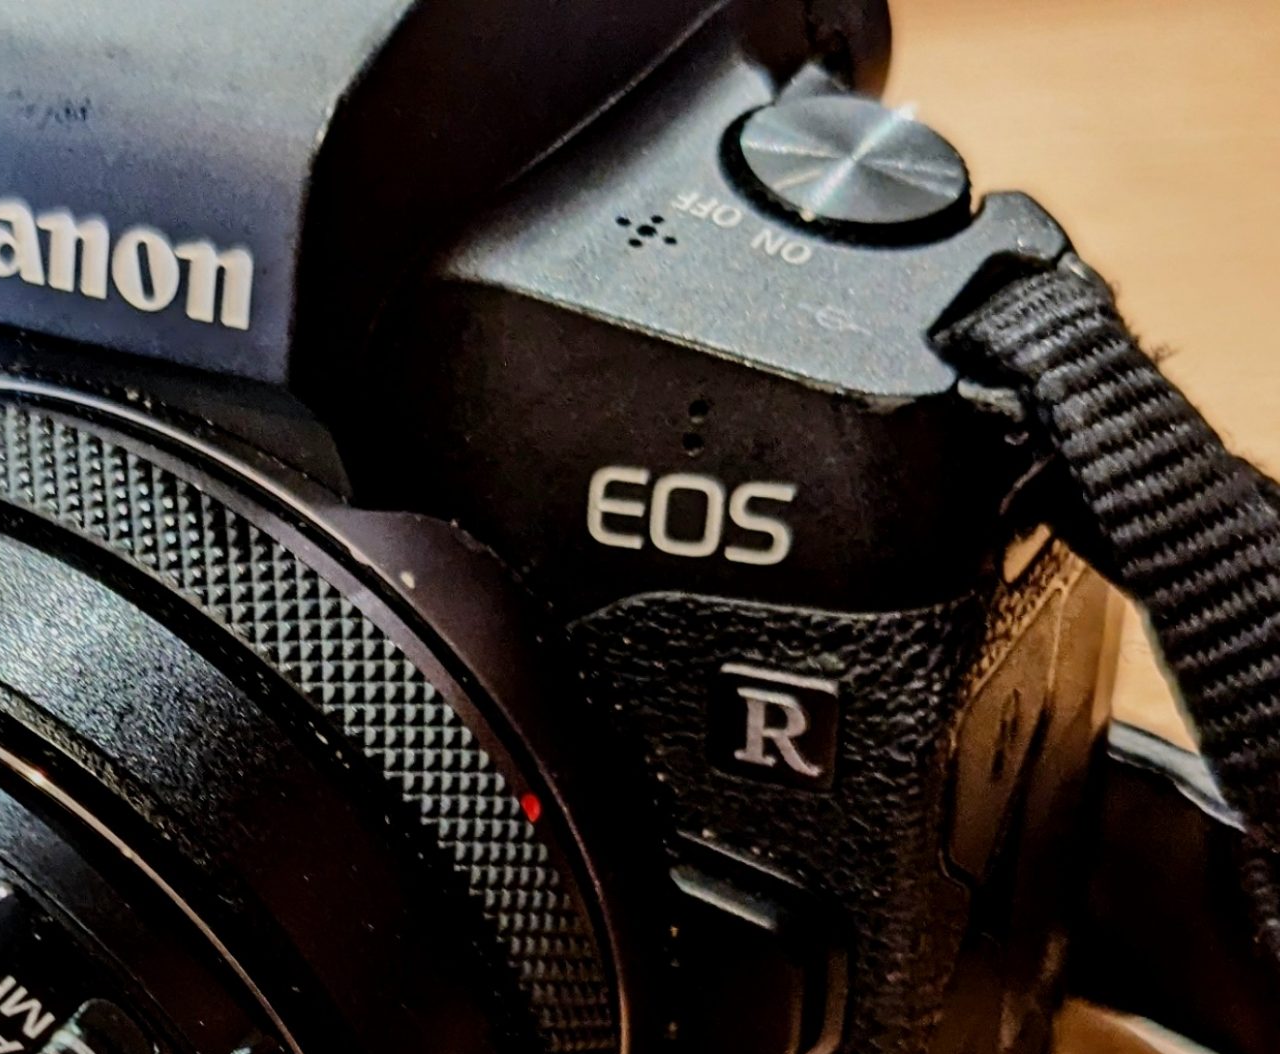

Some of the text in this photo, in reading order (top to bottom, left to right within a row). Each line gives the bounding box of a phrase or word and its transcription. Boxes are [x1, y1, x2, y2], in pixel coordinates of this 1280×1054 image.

[671, 192, 742, 228] OFF
[750, 229, 812, 265] ON
[587, 465, 796, 566] EOS
[733, 686, 820, 777] R
